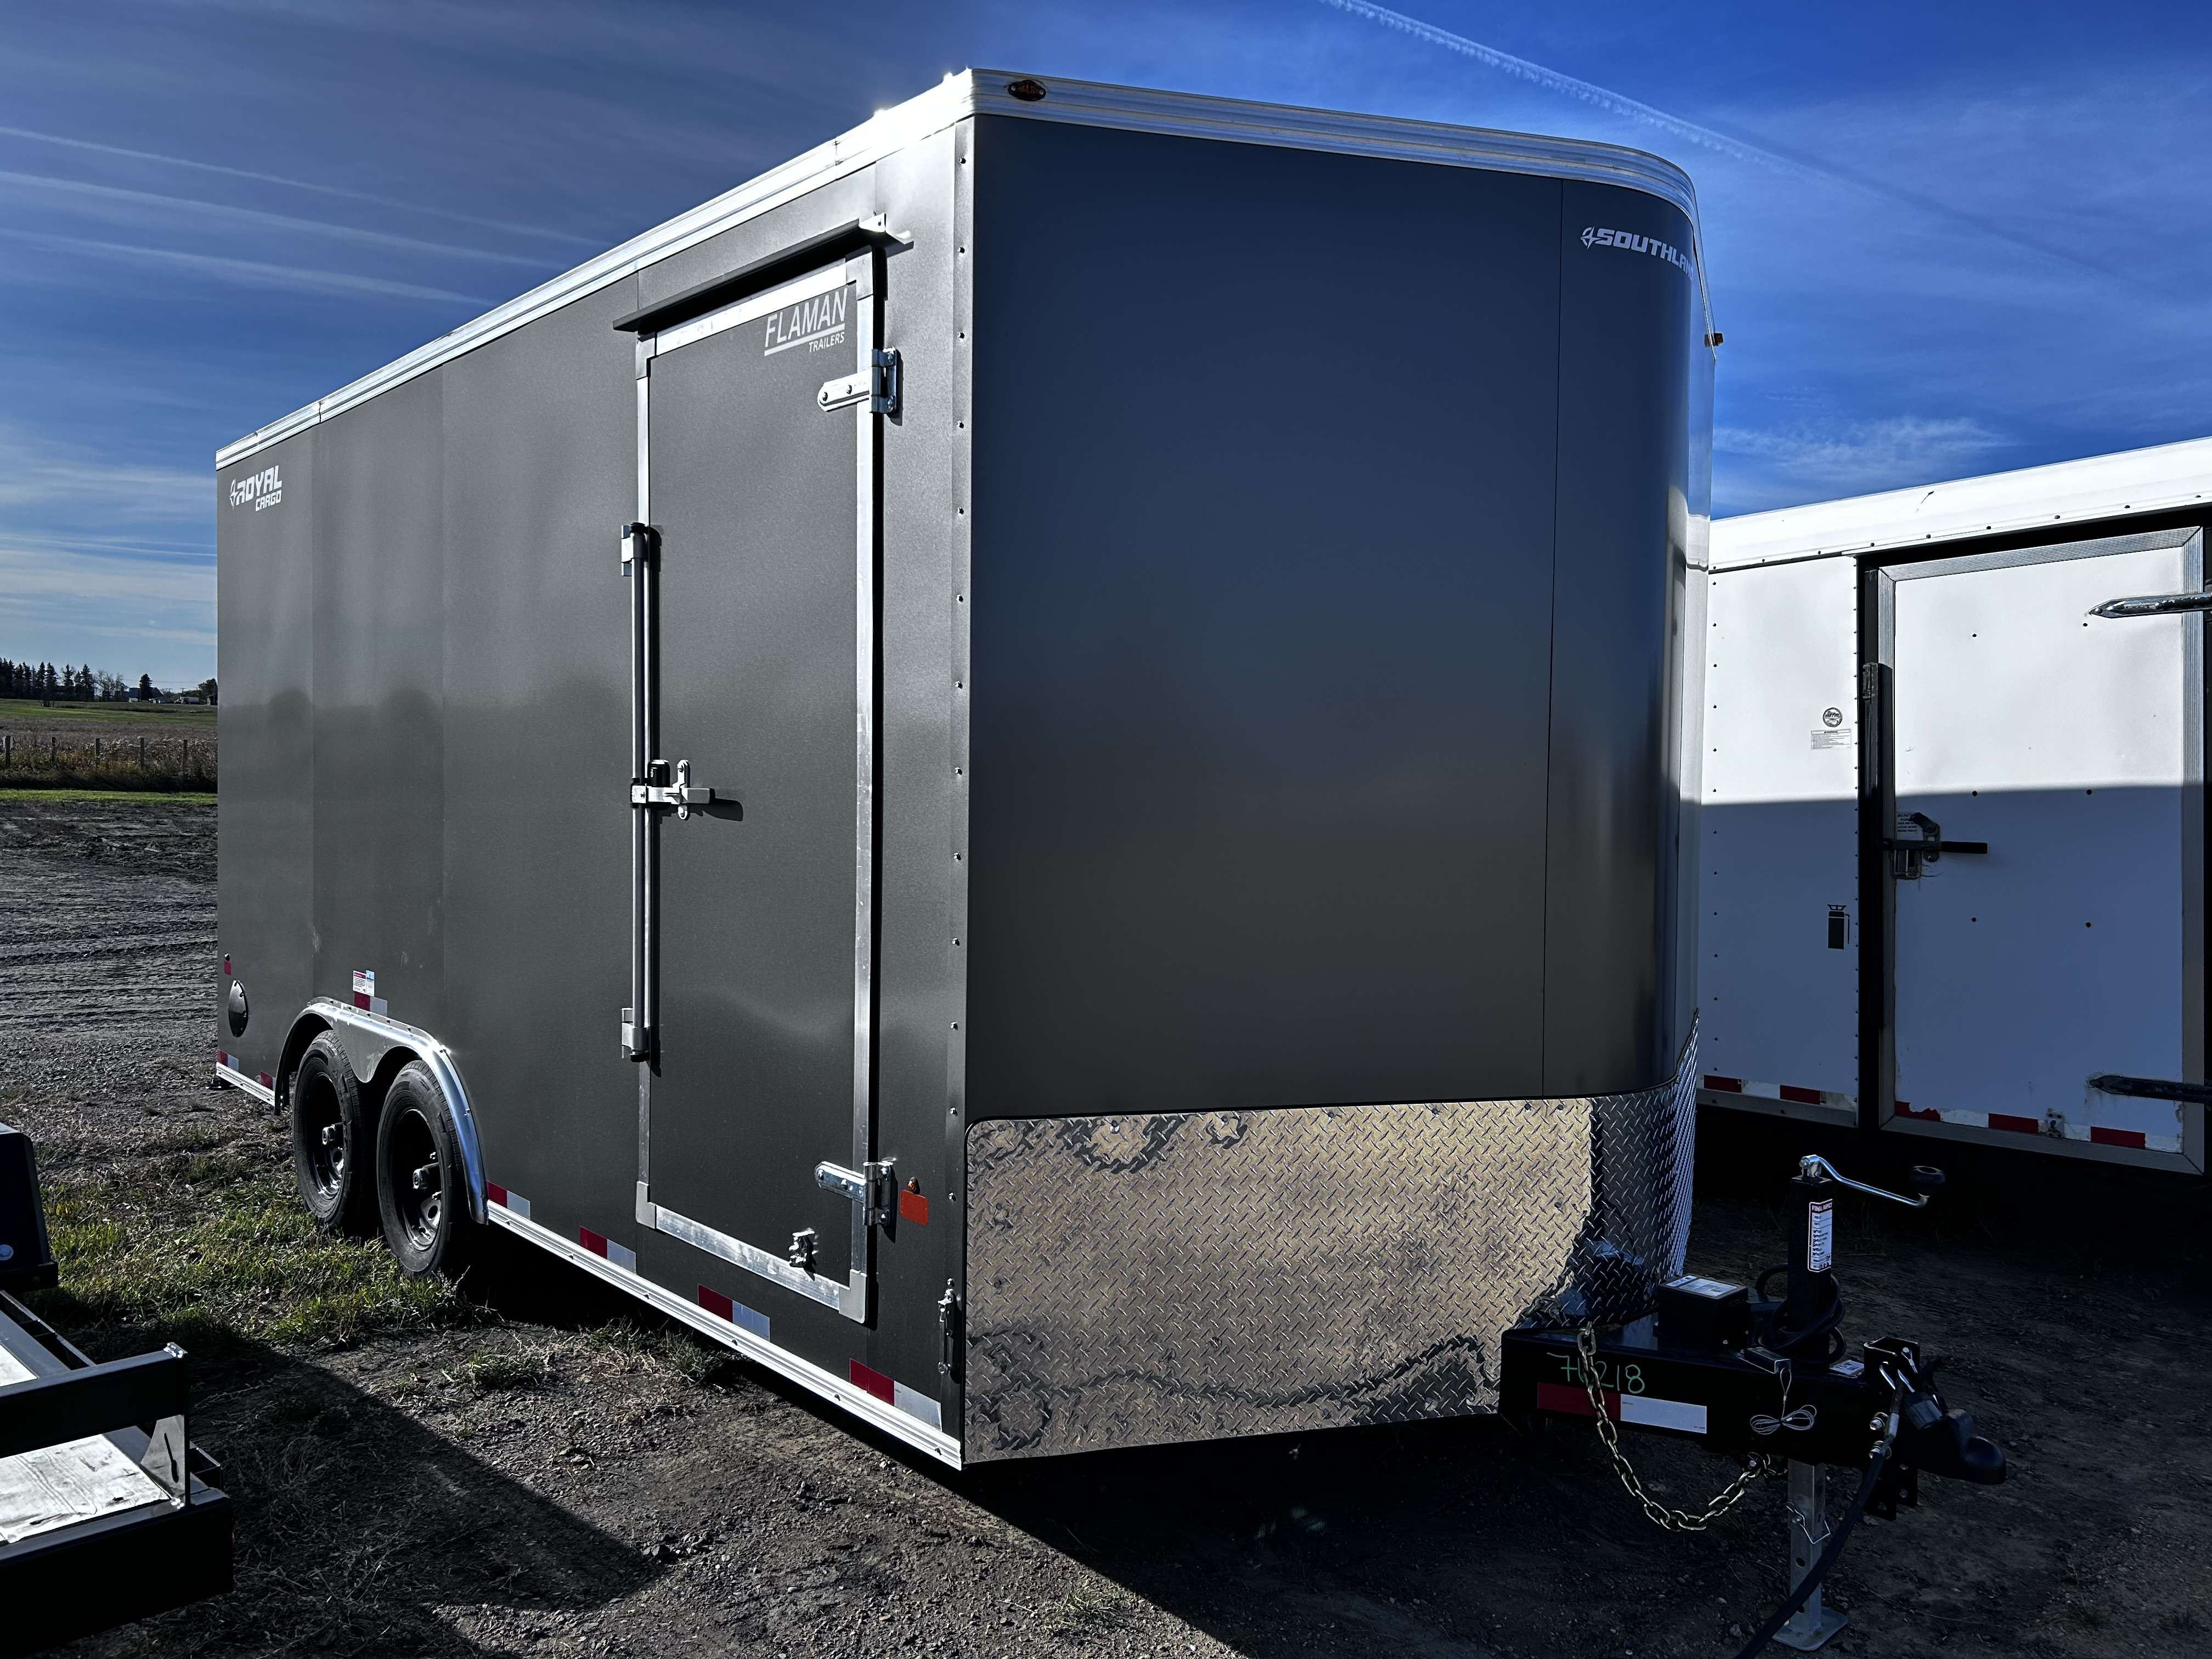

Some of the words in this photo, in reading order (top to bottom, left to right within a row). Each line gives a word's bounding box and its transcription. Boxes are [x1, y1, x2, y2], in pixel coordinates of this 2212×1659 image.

[765, 288, 848, 347] FLAMAN
[809, 332, 845, 353] TRAILERS
[236, 465, 282, 505] ROYAL
[255, 490, 281, 511] CARGO
